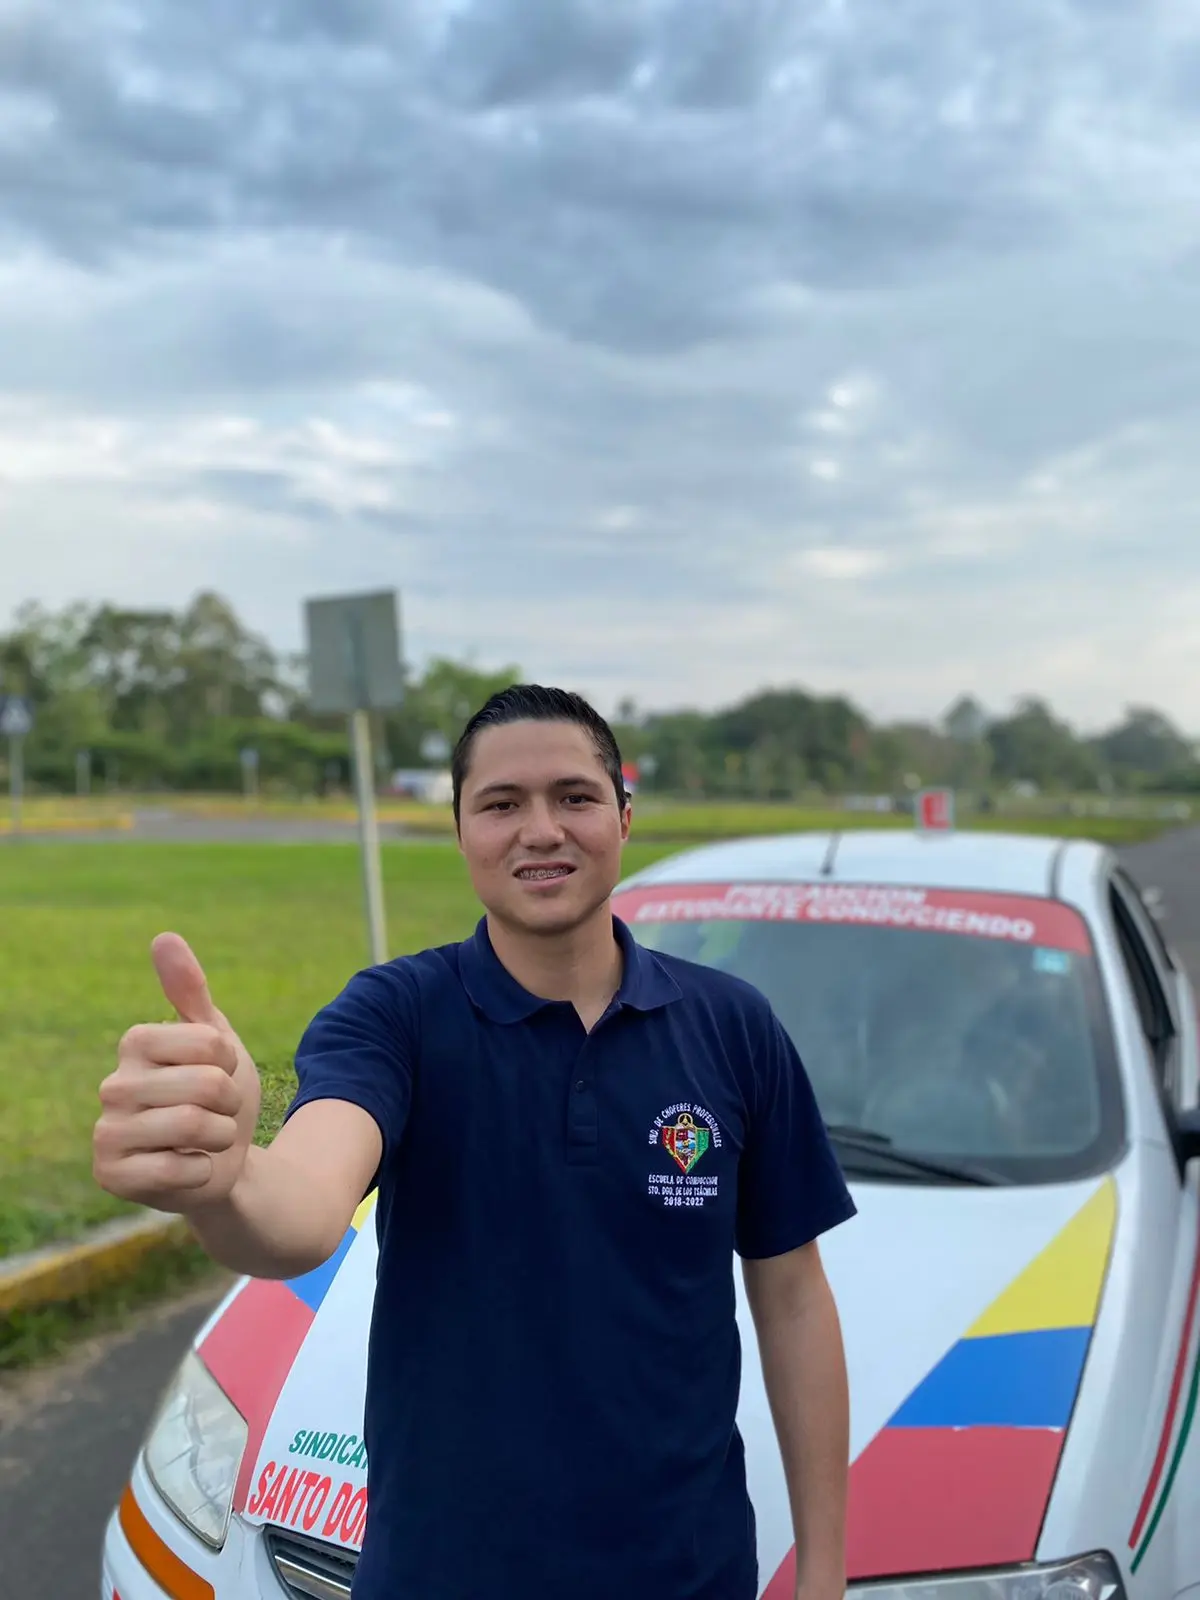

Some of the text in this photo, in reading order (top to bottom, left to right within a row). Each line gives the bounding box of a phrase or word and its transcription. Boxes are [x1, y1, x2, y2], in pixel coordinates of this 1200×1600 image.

[805, 902, 1035, 941] CONDUCIENDO
[653, 1116, 664, 1128] DE
[661, 1102, 692, 1119] CHOFERES
[692, 1104, 722, 1148] PROFESIONALES
[648, 1174, 675, 1185] ESCUELA
[676, 1175, 684, 1185] DE
[675, 1186, 683, 1196] DE
[683, 1187, 693, 1196] LOS
[663, 1196, 704, 1207] 2018-2022
[248, 1460, 332, 1531] SANTO
